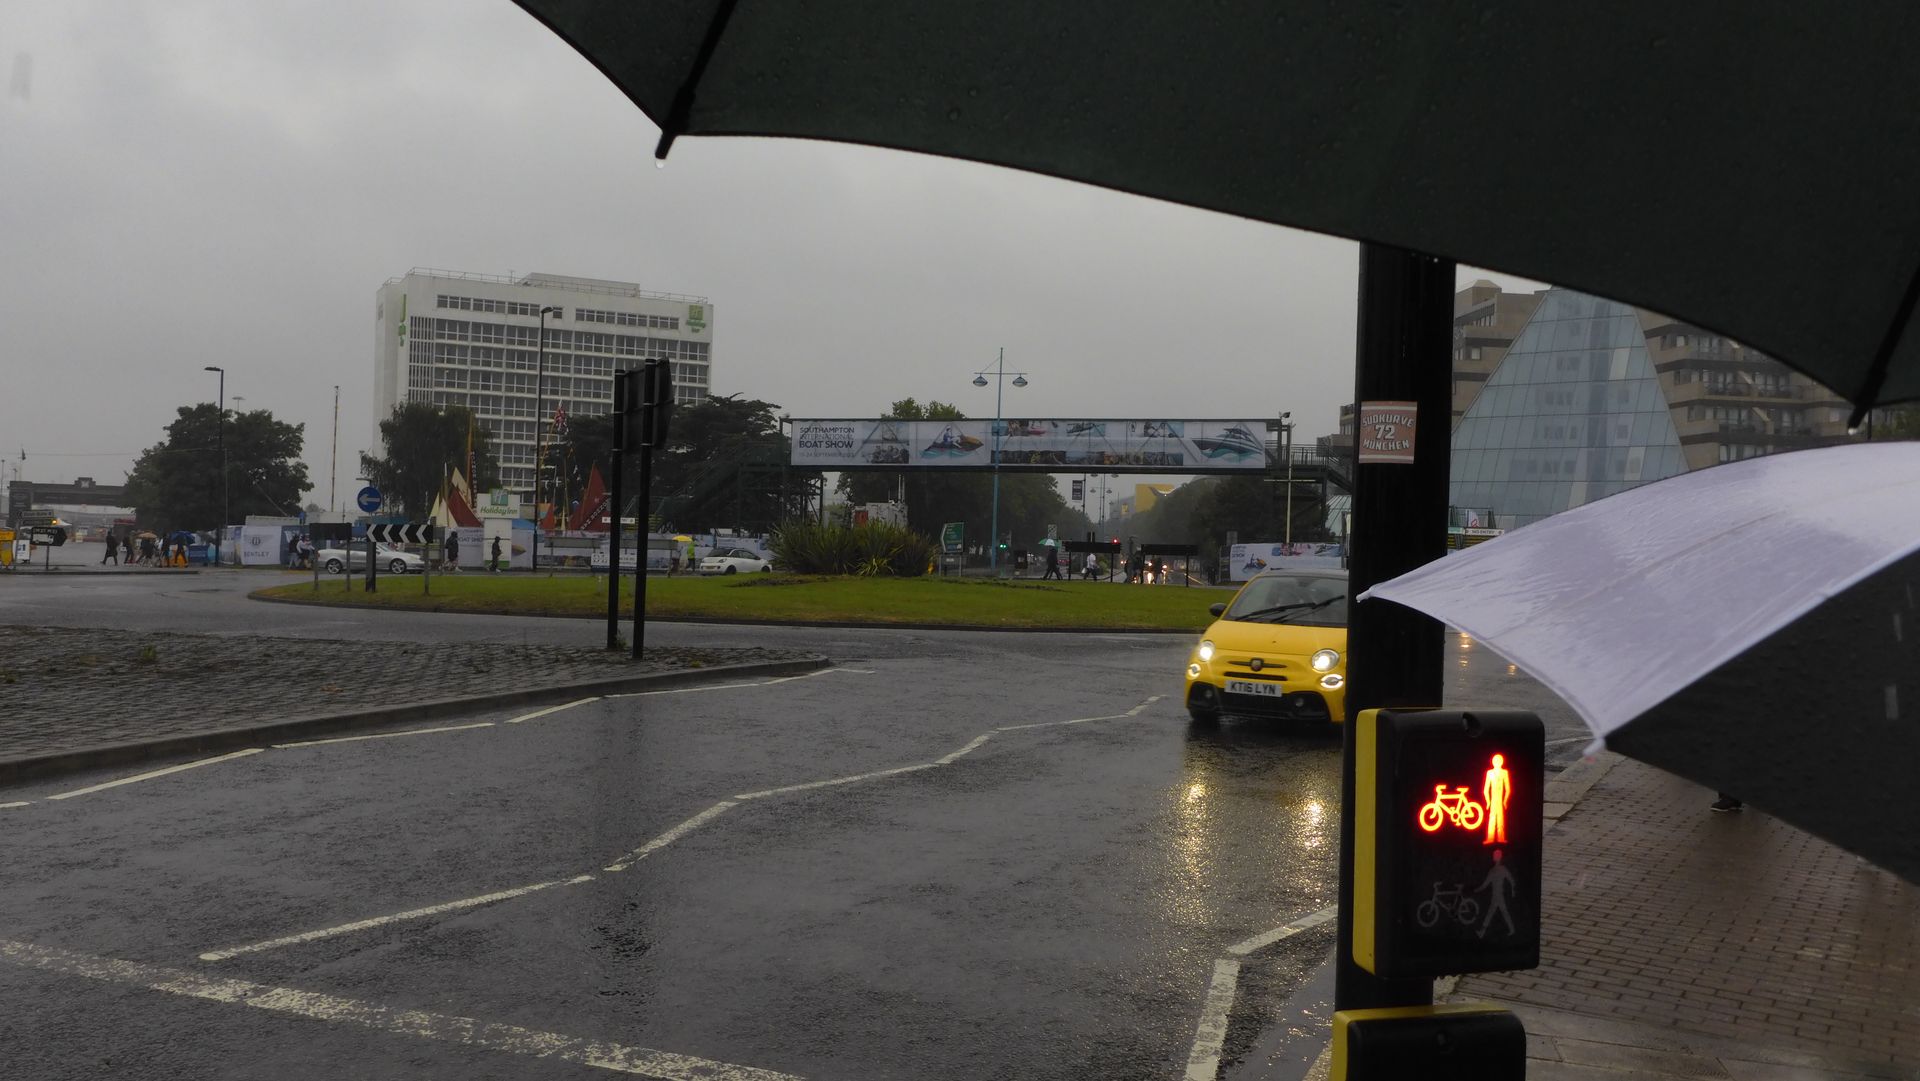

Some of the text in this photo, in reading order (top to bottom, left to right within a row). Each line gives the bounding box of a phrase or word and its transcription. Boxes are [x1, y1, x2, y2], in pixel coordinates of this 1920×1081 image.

[799, 426, 855, 434] SOUTHAMPTON
[1375, 424, 1396, 440] 72
[799, 440, 854, 449] BOAT SHOW
[480, 505, 507, 516] Holiday
[1255, 684, 1277, 696] LYN
